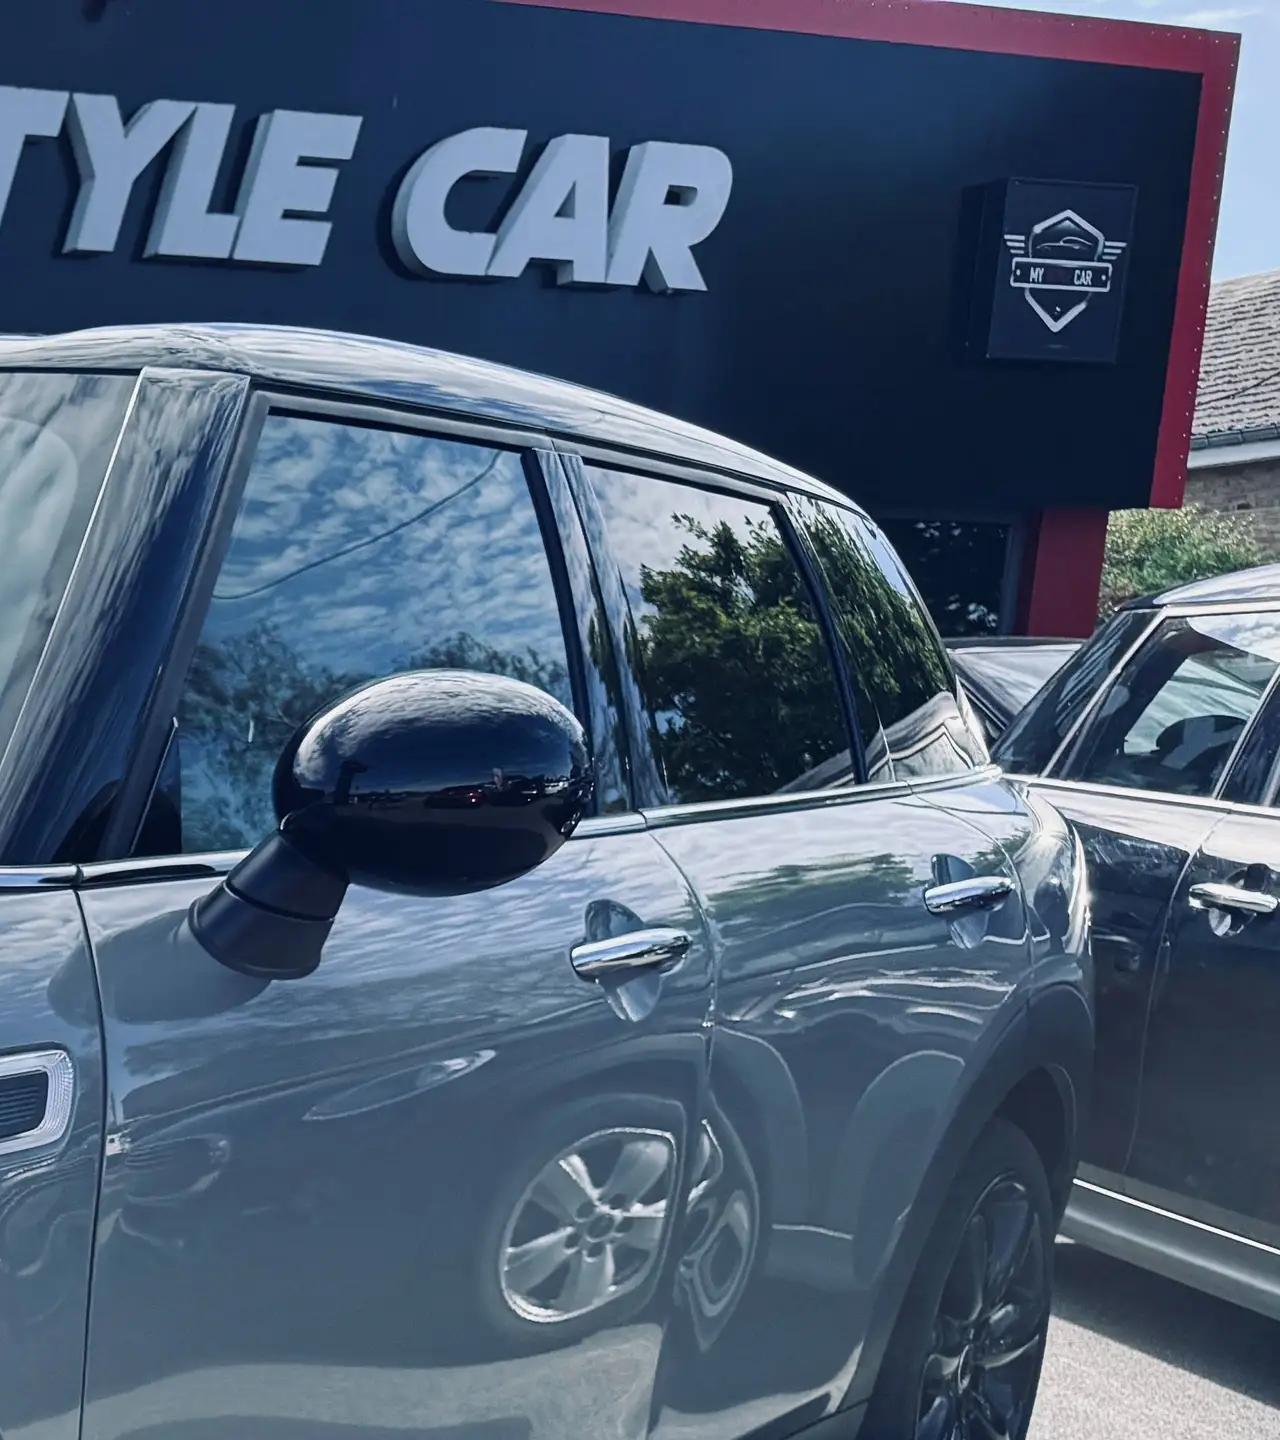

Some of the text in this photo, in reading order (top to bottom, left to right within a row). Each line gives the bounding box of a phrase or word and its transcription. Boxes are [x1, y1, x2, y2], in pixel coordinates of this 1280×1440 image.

[391, 126, 734, 294] CAR
[1029, 266, 1045, 283] MY
[1073, 269, 1093, 286] CAR
